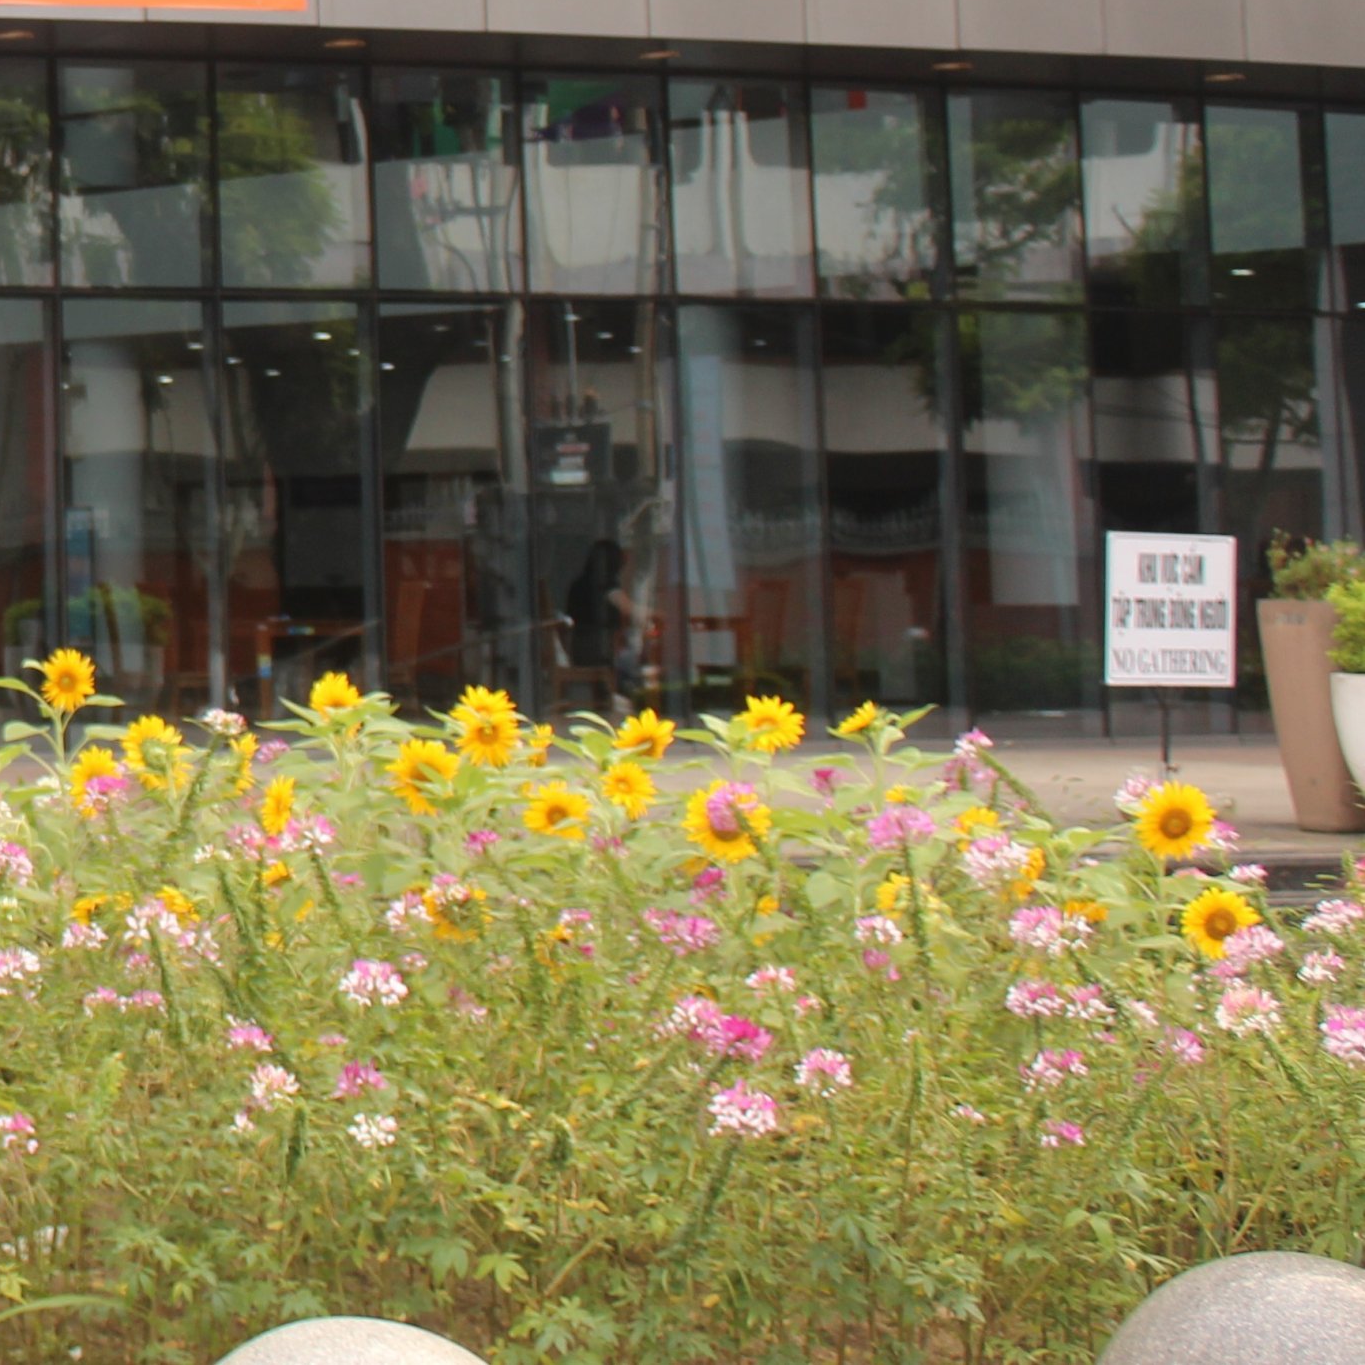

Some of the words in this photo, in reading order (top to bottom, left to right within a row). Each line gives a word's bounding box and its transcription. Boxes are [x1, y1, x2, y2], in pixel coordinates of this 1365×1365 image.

[1138, 552, 1158, 584] KHU
[1134, 597, 1167, 629] TRUNG
[1112, 648, 1137, 674] NO
[1137, 648, 1227, 675] GATHERING
